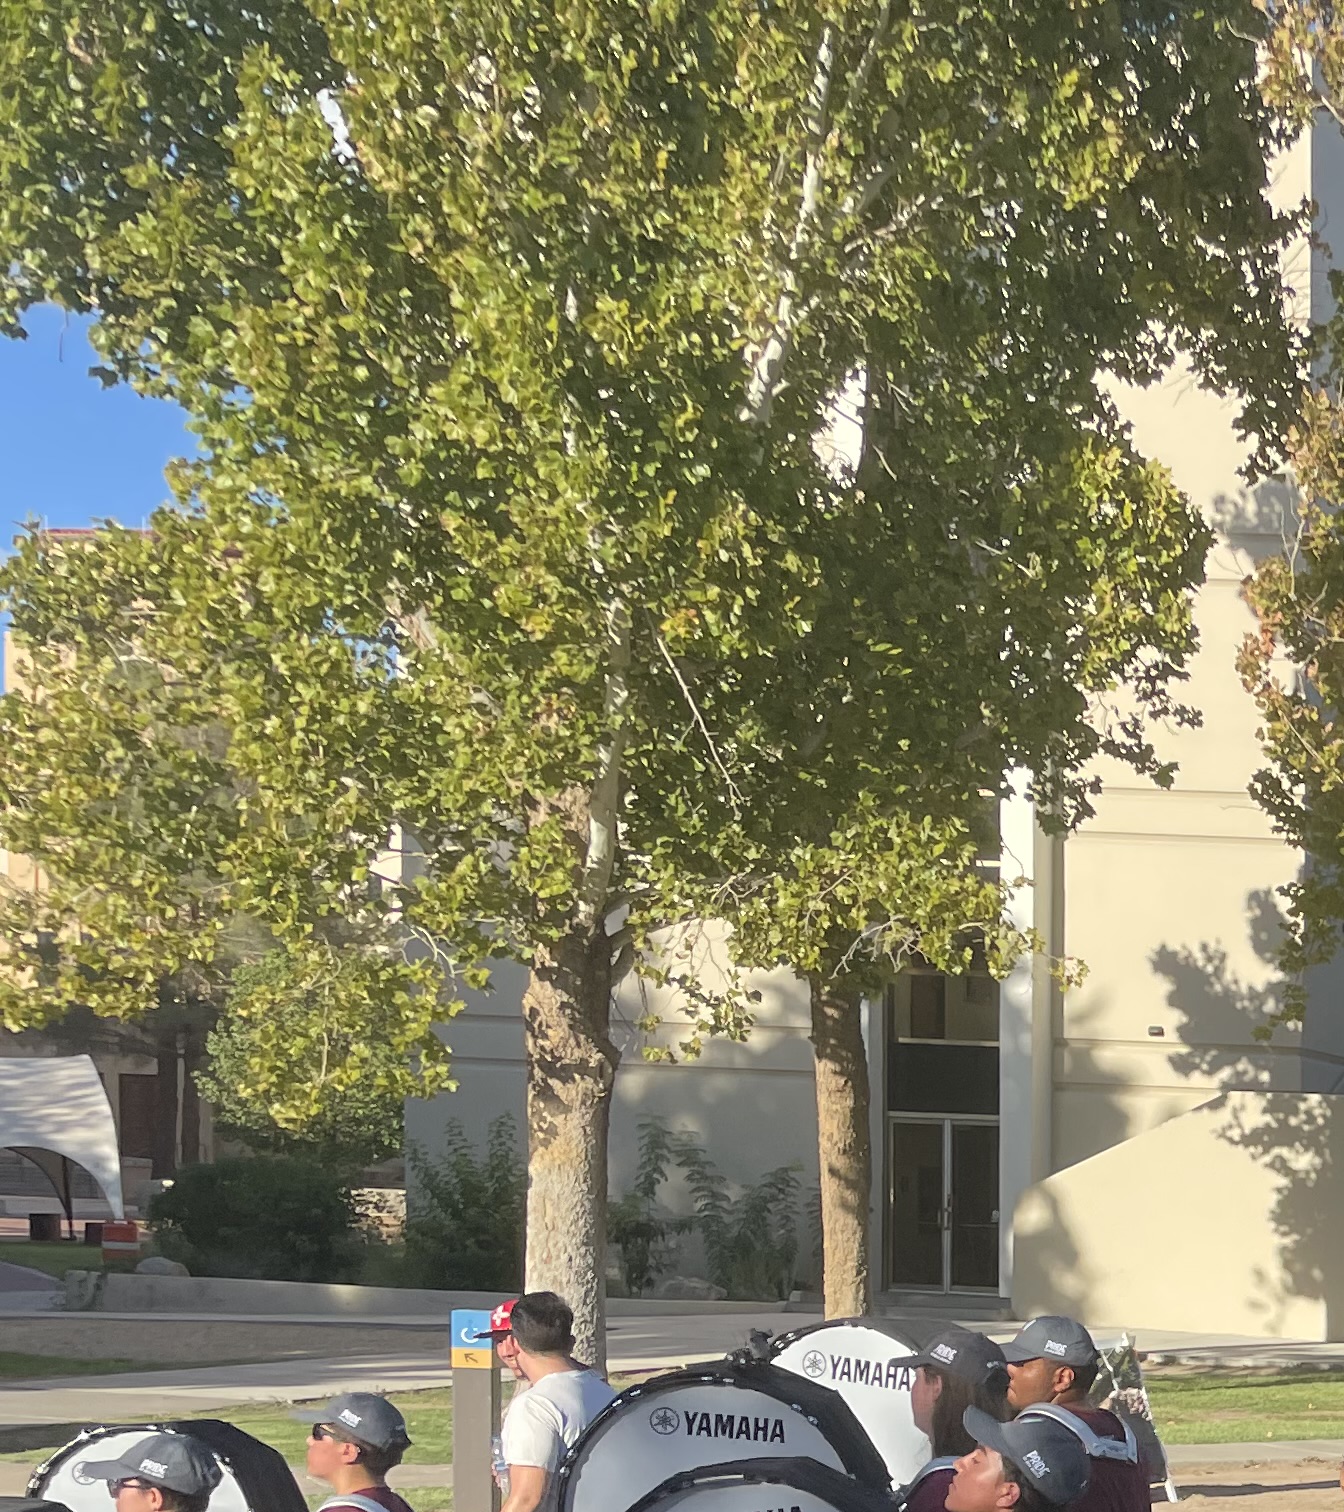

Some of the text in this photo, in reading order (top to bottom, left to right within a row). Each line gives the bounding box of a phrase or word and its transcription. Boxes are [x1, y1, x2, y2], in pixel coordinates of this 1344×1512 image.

[830, 1354, 911, 1392] YAMAHA
[684, 1411, 785, 1444] YAMAHA
[1026, 1450, 1050, 1476] PRIDE
